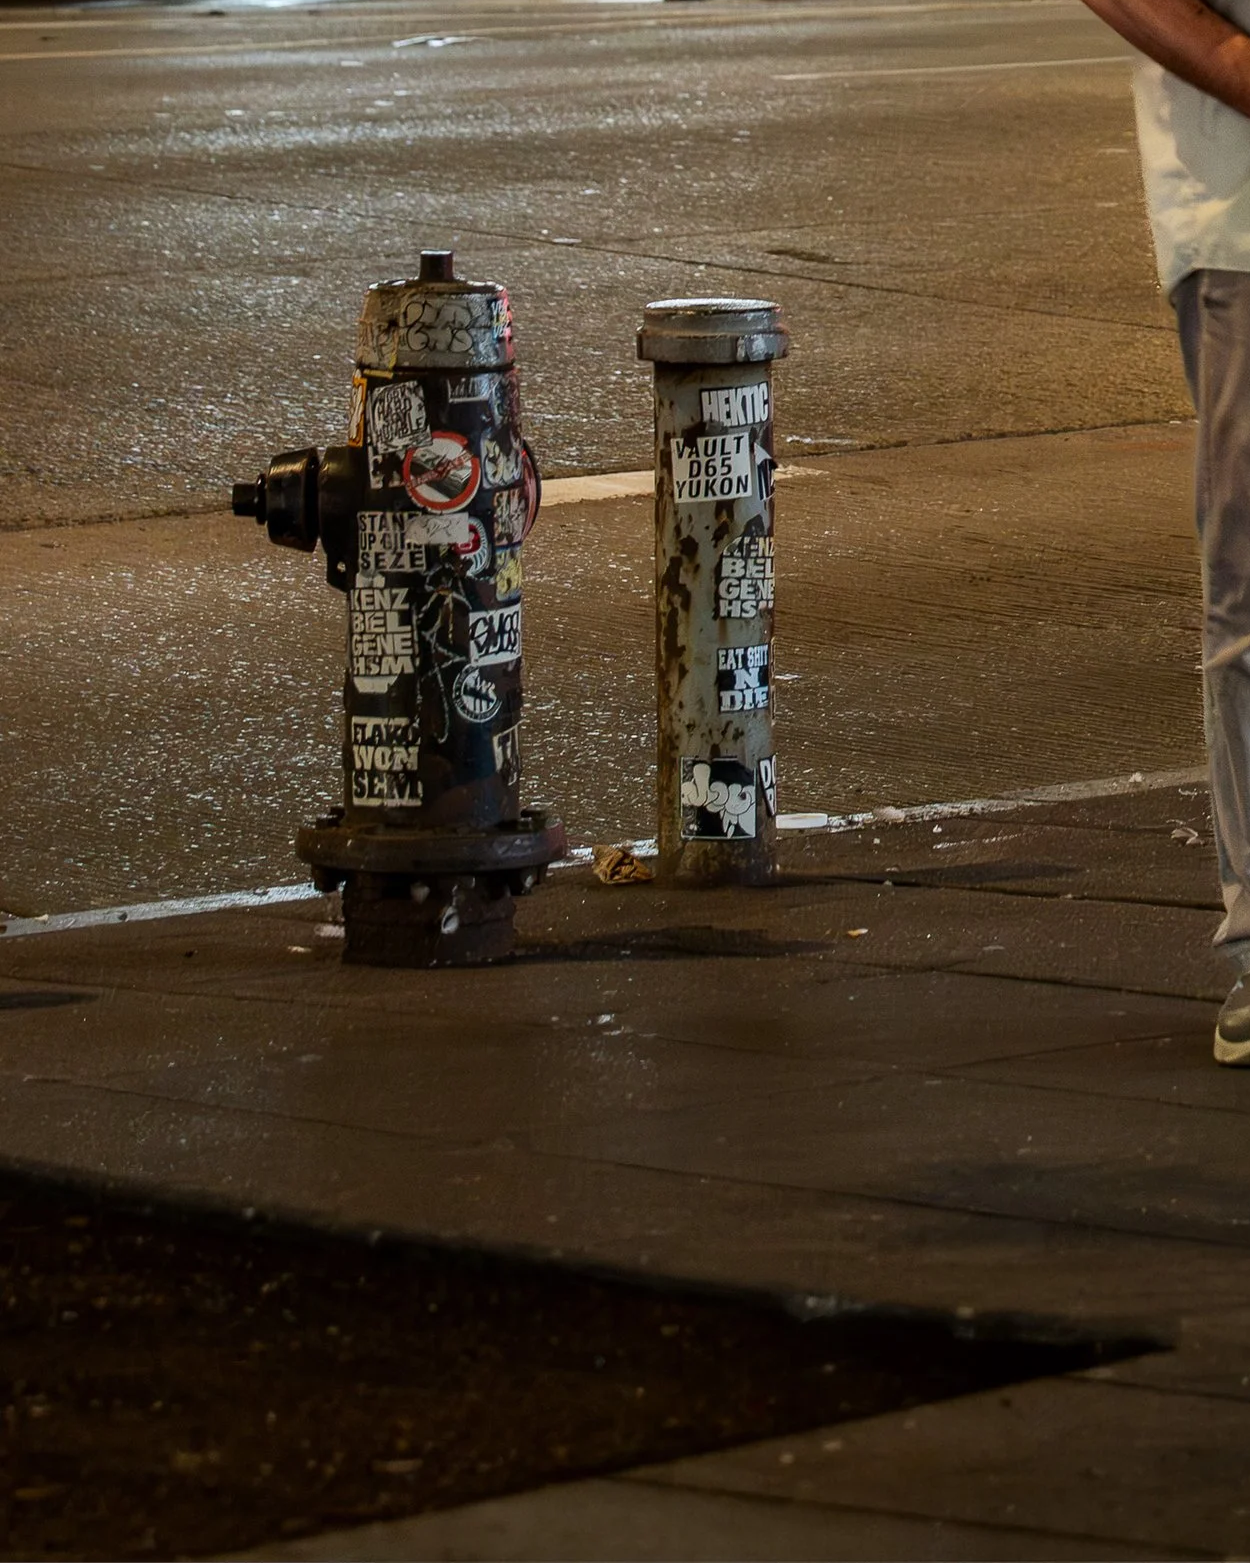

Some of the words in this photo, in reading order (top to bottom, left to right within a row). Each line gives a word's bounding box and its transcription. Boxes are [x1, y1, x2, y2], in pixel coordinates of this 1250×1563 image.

[701, 382, 769, 427] HEKTIC
[675, 435, 745, 459] VAULT
[689, 456, 732, 479] D65
[675, 474, 749, 499] YUKON
[359, 513, 422, 533] STAN
[360, 551, 424, 571] SEZE
[350, 589, 409, 611] KENZ
[352, 611, 412, 634] BEL
[351, 633, 413, 656] GENE
[718, 648, 744, 670] EAT
[747, 644, 769, 668] SHIT
[733, 667, 760, 690] N
[719, 686, 769, 712] DIE
